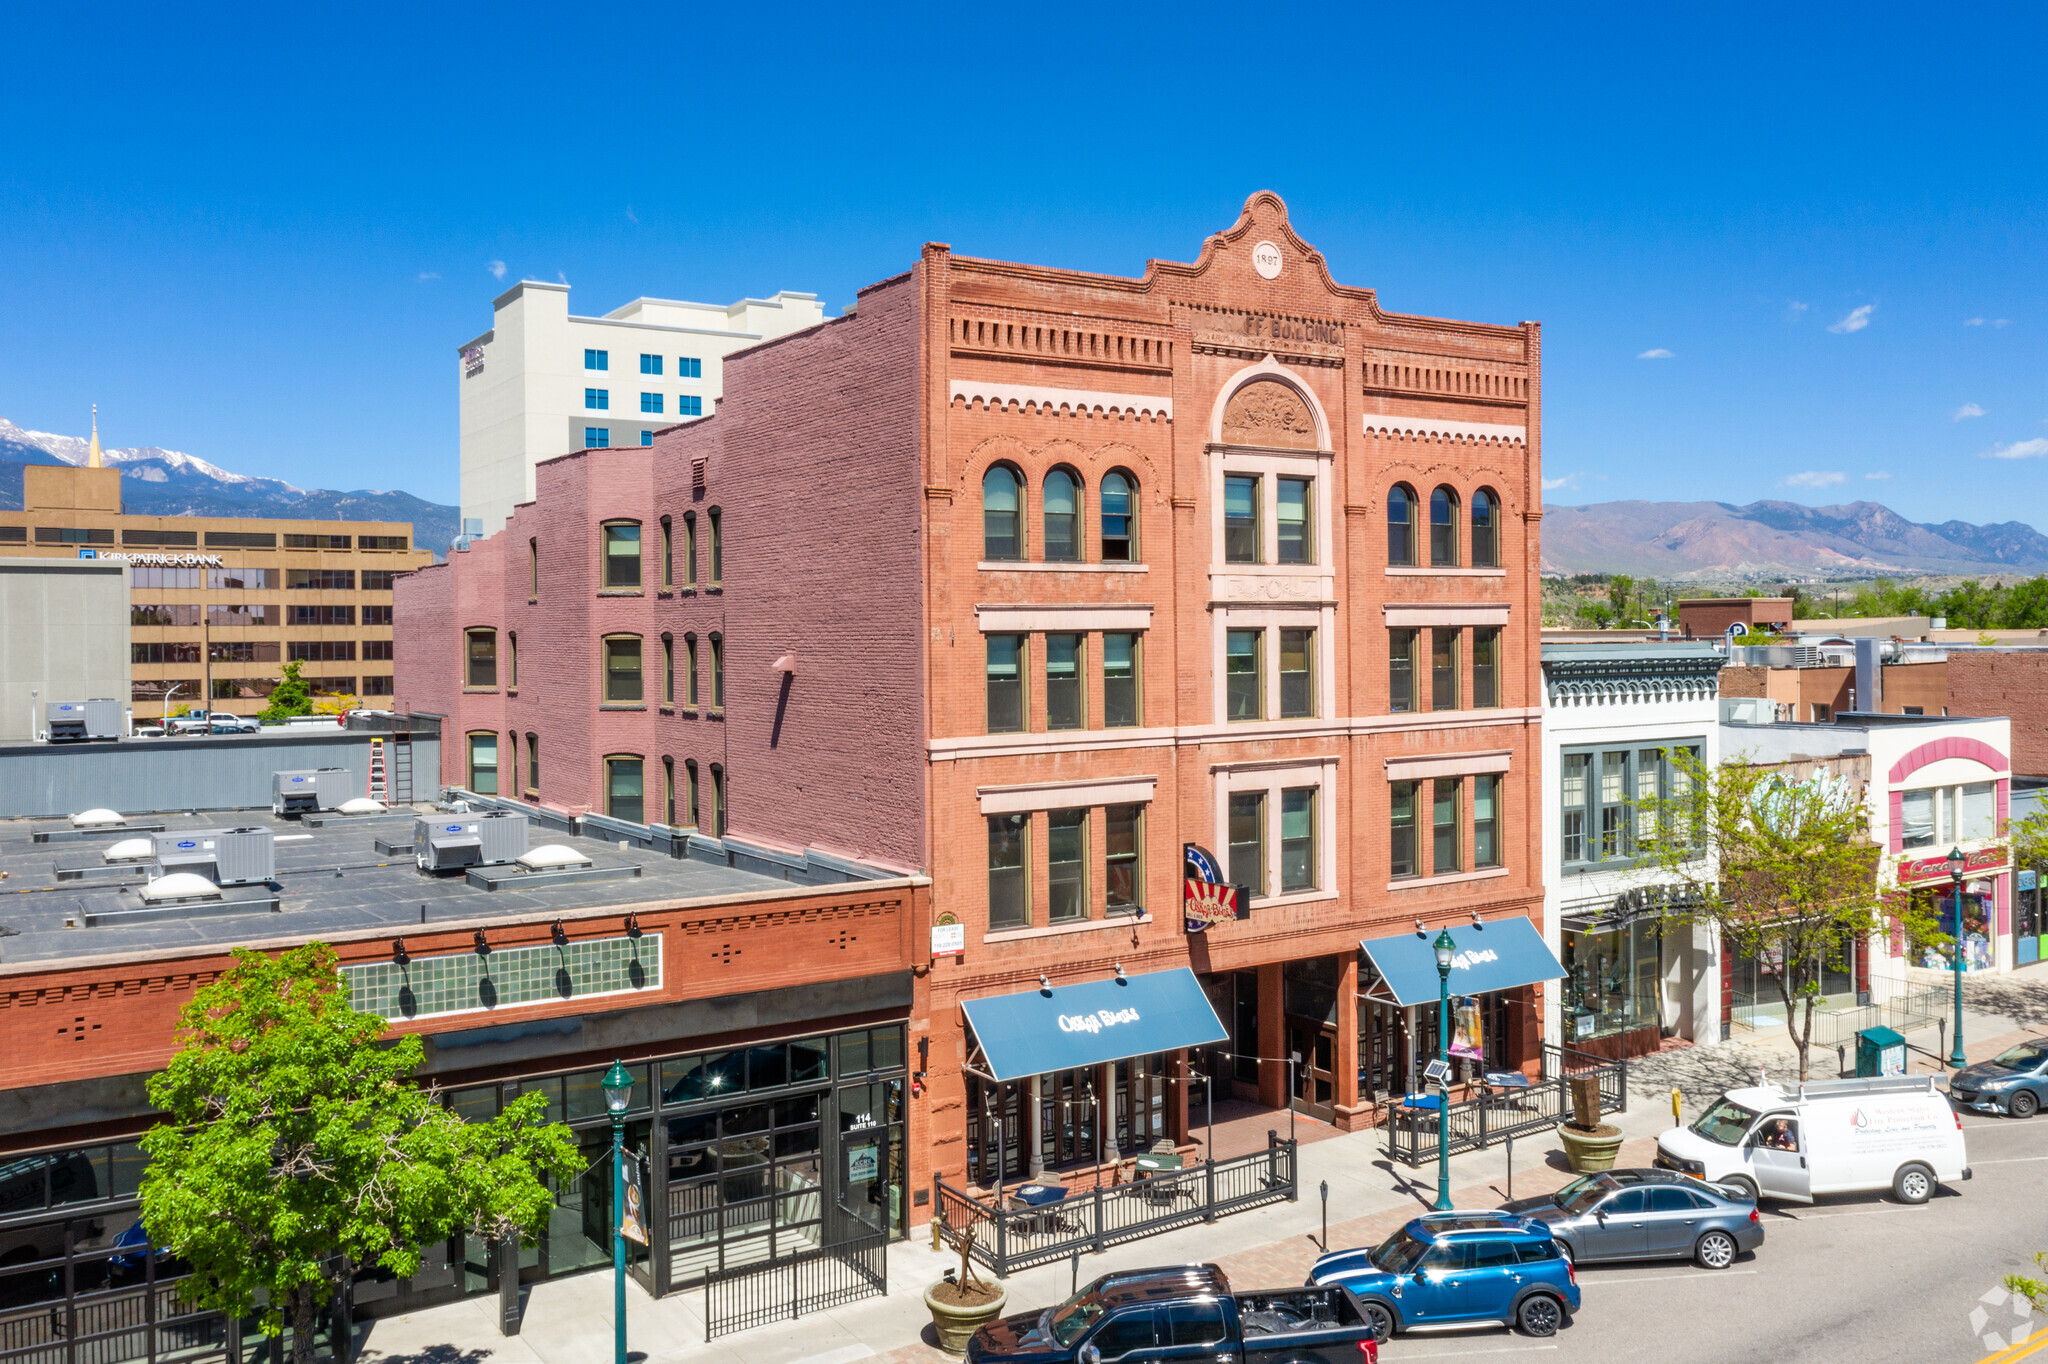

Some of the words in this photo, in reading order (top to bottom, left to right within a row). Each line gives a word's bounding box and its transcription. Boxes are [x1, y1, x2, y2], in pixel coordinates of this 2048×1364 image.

[1257, 254, 1278, 266] 1897
[99, 551, 185, 565] KIRKPATRICK
[186, 553, 223, 565] BANK
[1733, 625, 1743, 637] P
[856, 1113, 871, 1124] 114
[850, 1122, 867, 1131] SUITE
